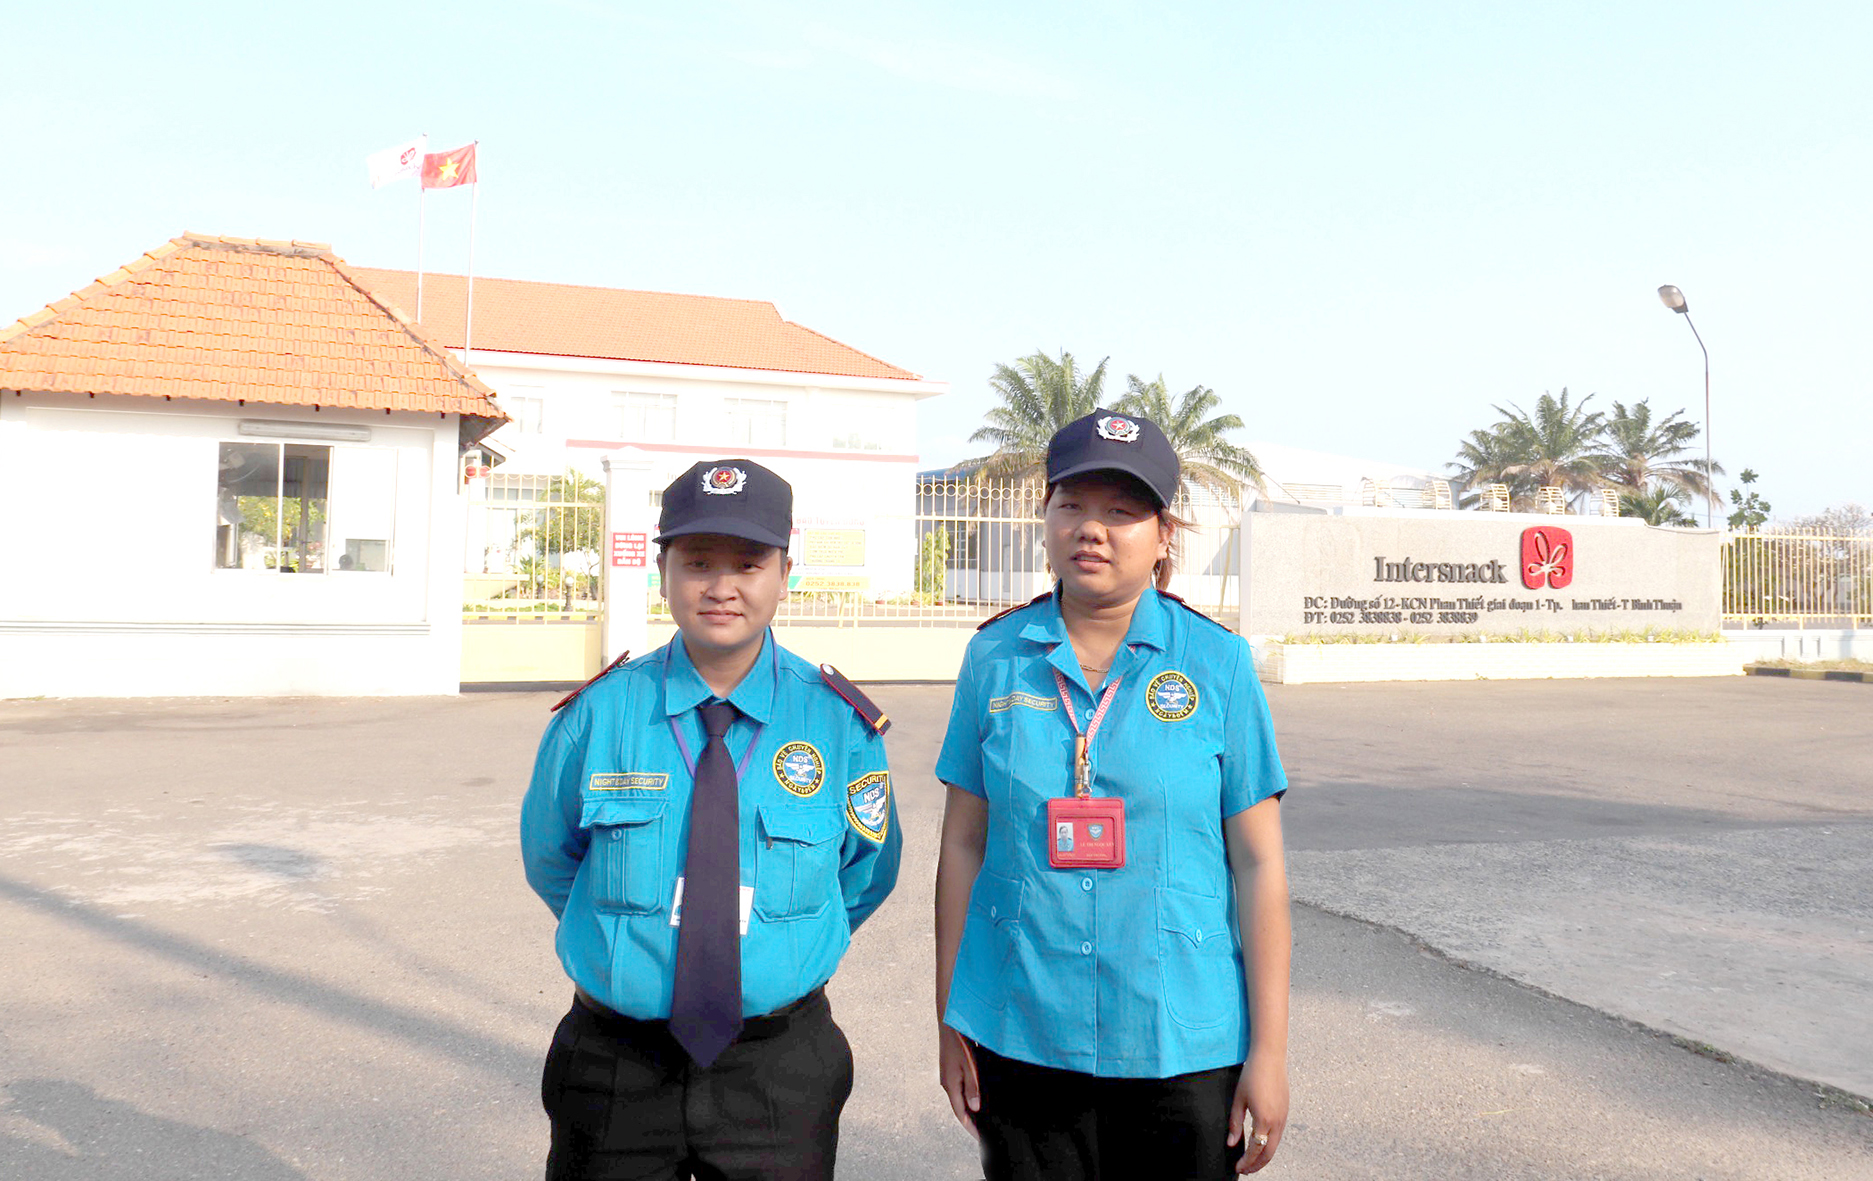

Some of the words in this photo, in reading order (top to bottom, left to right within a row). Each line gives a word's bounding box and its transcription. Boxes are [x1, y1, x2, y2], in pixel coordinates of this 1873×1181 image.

[1374, 556, 1508, 584] Intersnack
[1330, 611, 1355, 624] 0252
[1410, 611, 1434, 624] 0252
[792, 755, 808, 764] NDS
[630, 776, 664, 786] SECURITY
[863, 786, 880, 804] NDS
